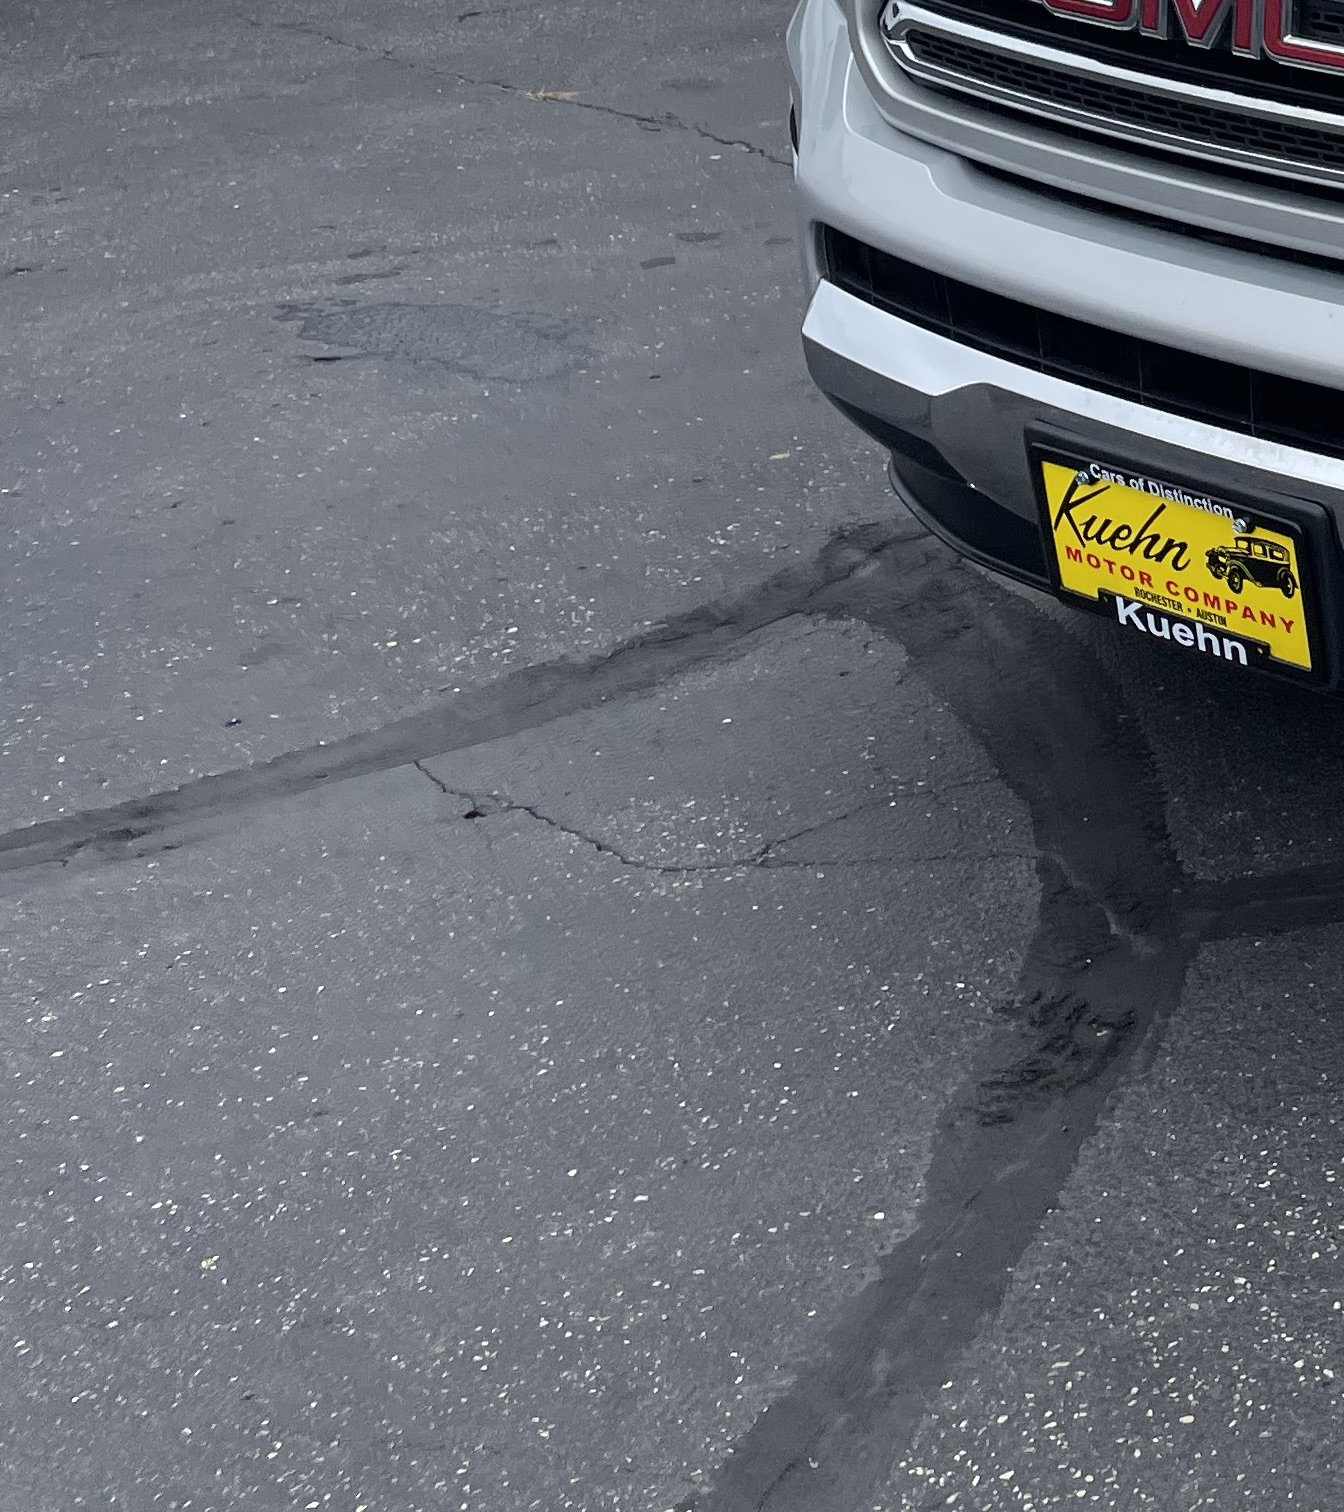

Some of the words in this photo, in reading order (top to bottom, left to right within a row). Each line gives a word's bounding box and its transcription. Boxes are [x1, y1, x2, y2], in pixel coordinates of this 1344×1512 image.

[1053, 473, 1192, 572] Kuehn
[1089, 463, 1126, 486] Cars
[1129, 478, 1145, 492] of
[1148, 480, 1234, 519] Distinction
[1065, 545, 1154, 588] MOTOR
[1165, 579, 1295, 634] COMPANY
[1134, 586, 1184, 613] ROCHESTER
[1196, 607, 1228, 628] AUSTIN
[1115, 595, 1249, 666] Kuehn
